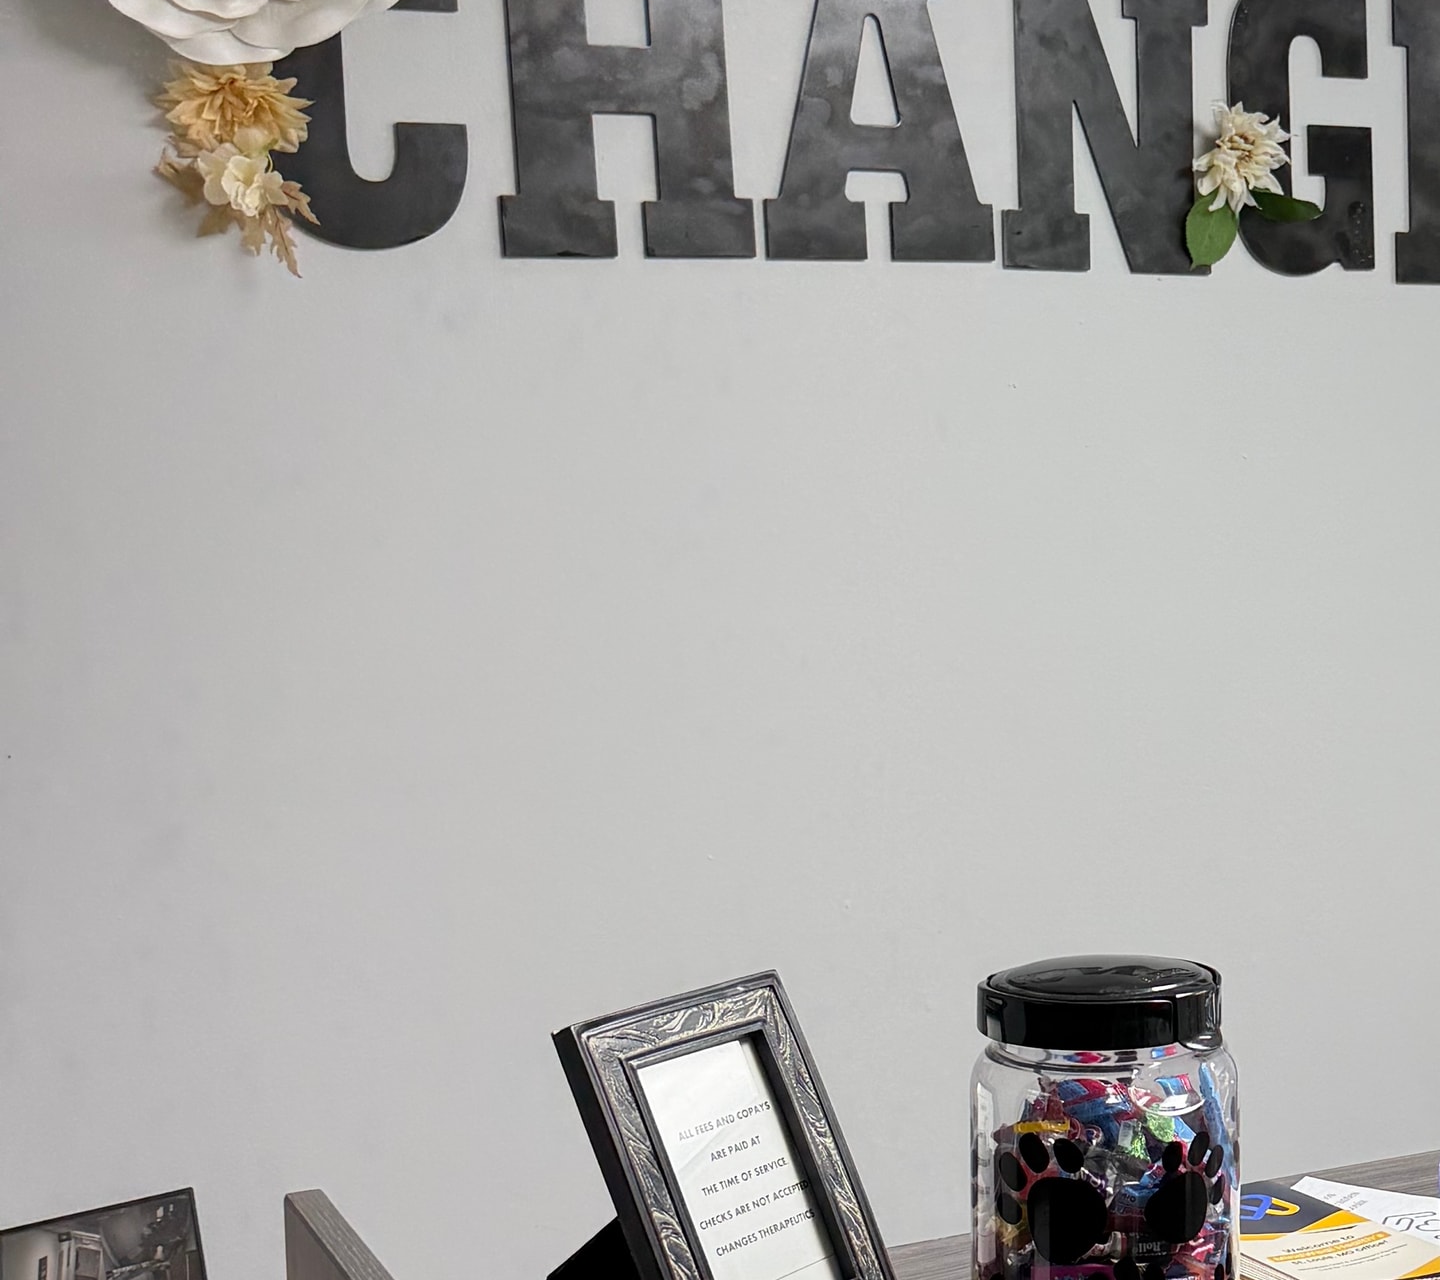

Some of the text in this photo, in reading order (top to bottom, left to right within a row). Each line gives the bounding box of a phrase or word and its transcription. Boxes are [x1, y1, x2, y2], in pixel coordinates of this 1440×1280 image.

[678, 1101, 771, 1142] ALL FEES AND COPAYS
[710, 1135, 761, 1162] ARE PAID AT
[701, 1183, 718, 1197] THE
[719, 1175, 740, 1191] TIME
[741, 1170, 753, 1182] OF
[699, 1210, 733, 1231] CHECKS
[735, 1203, 752, 1217] ARE
[752, 1195, 770, 1209] NOT
[716, 1208, 816, 1257] CHANGES THERAPEUTICS
